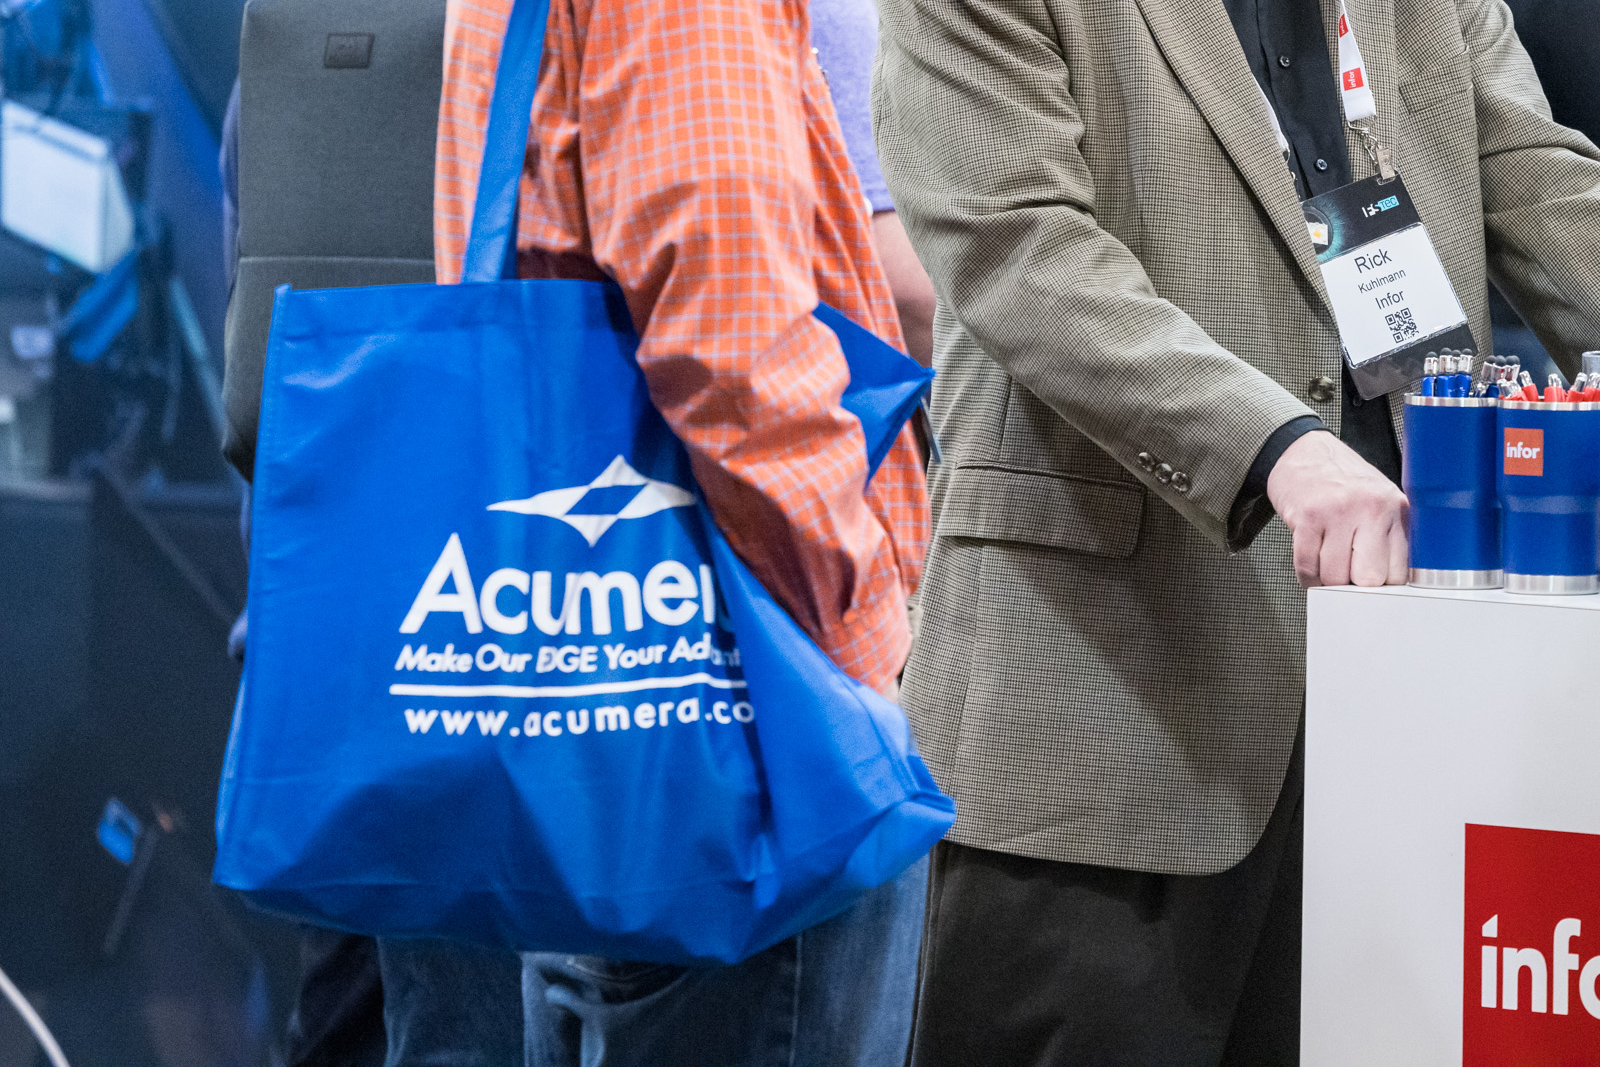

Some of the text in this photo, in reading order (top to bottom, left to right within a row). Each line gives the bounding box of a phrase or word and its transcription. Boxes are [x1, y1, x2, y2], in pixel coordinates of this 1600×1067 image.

[1348, 71, 1357, 88] infor
[1354, 249, 1392, 274] Rick
[1358, 269, 1406, 293] Kuhlmann
[1375, 291, 1405, 310] Infor
[1506, 441, 1541, 459] infor
[399, 532, 720, 635] Acumer
[395, 643, 473, 673] Make
[475, 643, 533, 673] Our
[603, 642, 668, 671] Your
